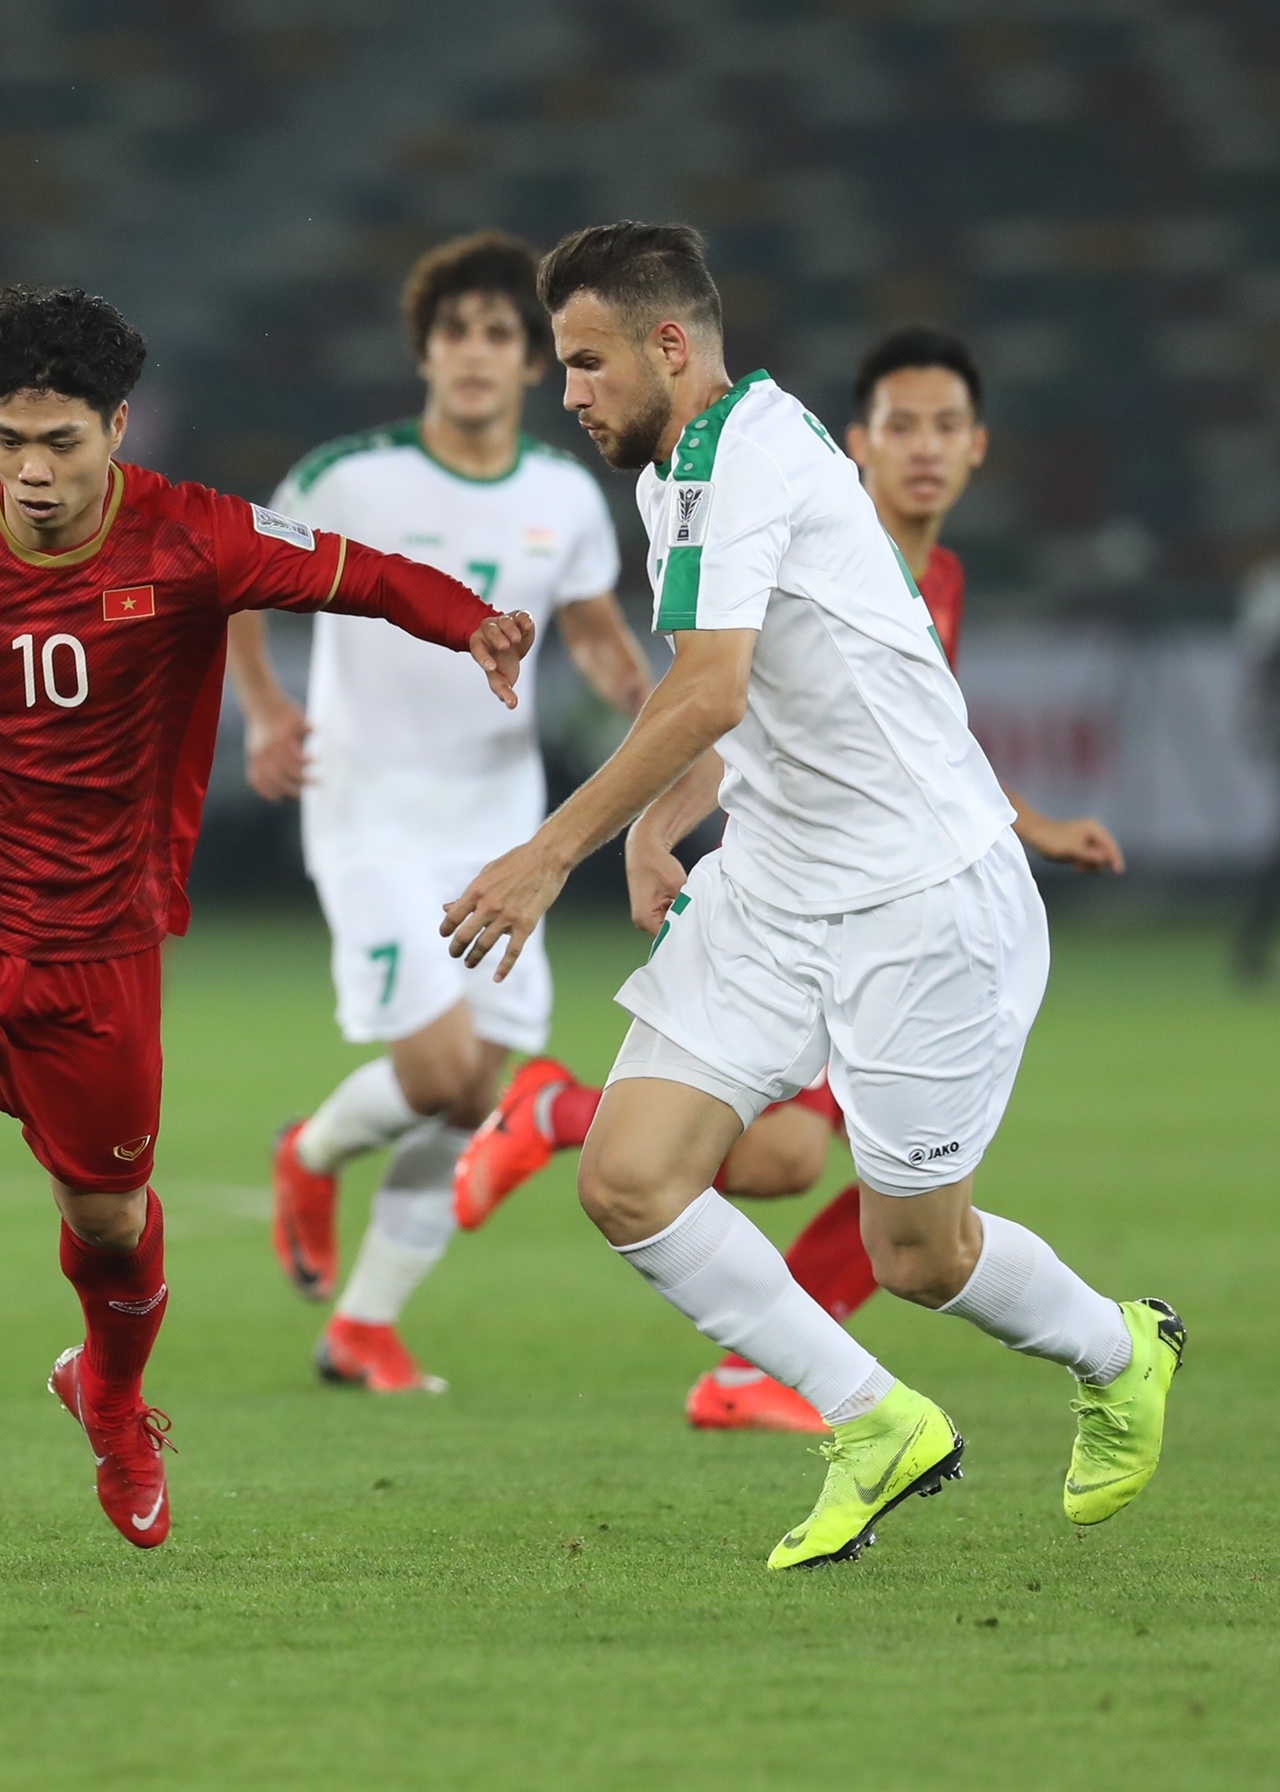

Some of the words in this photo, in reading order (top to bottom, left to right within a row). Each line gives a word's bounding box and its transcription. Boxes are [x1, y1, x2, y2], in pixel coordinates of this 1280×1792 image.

[467, 561, 498, 602] 7
[11, 633, 89, 708] 10
[369, 943, 399, 1005] 7
[927, 1141, 959, 1160] JAKO
